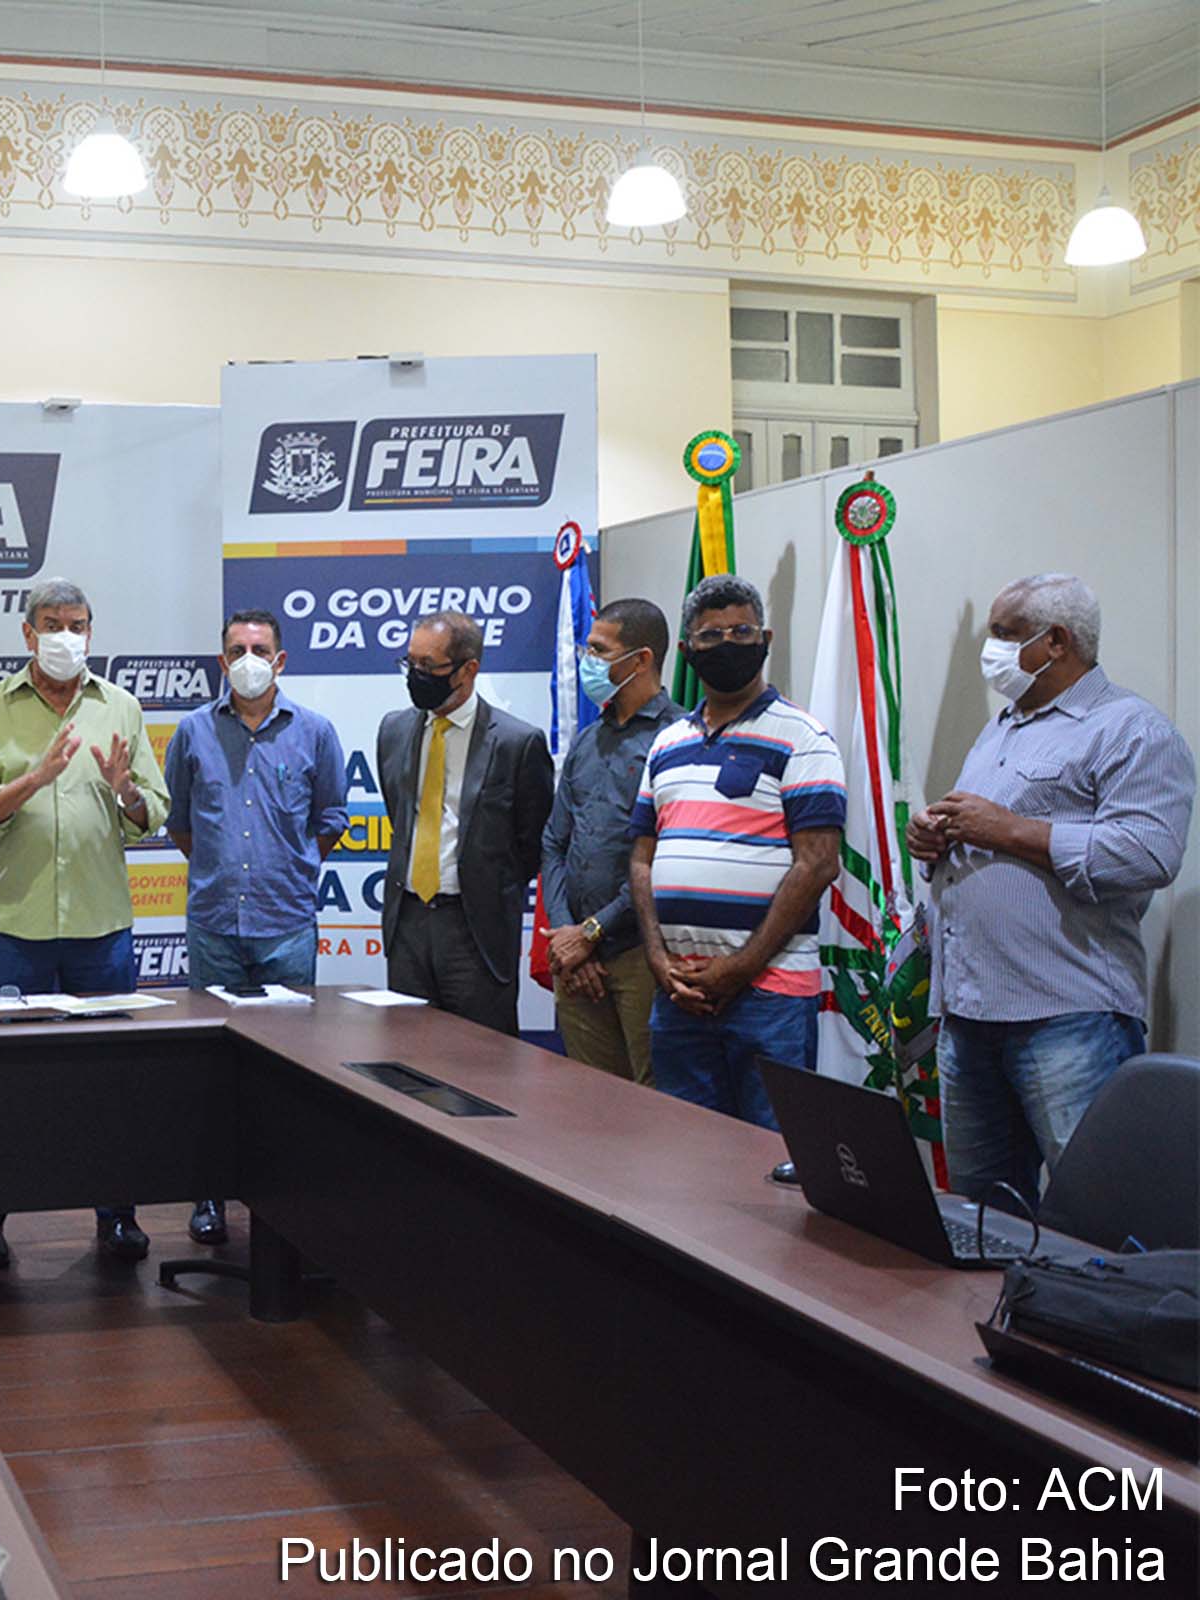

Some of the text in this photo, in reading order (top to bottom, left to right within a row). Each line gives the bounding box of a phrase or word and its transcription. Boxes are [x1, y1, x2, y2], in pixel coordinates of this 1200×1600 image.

[390, 424, 511, 438] PREFEITURA DE
[366, 436, 539, 489] FEIRA
[283, 585, 532, 618] O GOVERNO
[309, 621, 366, 649] DA
[116, 668, 211, 698] FEIRA
[129, 873, 187, 889] GOVERN
